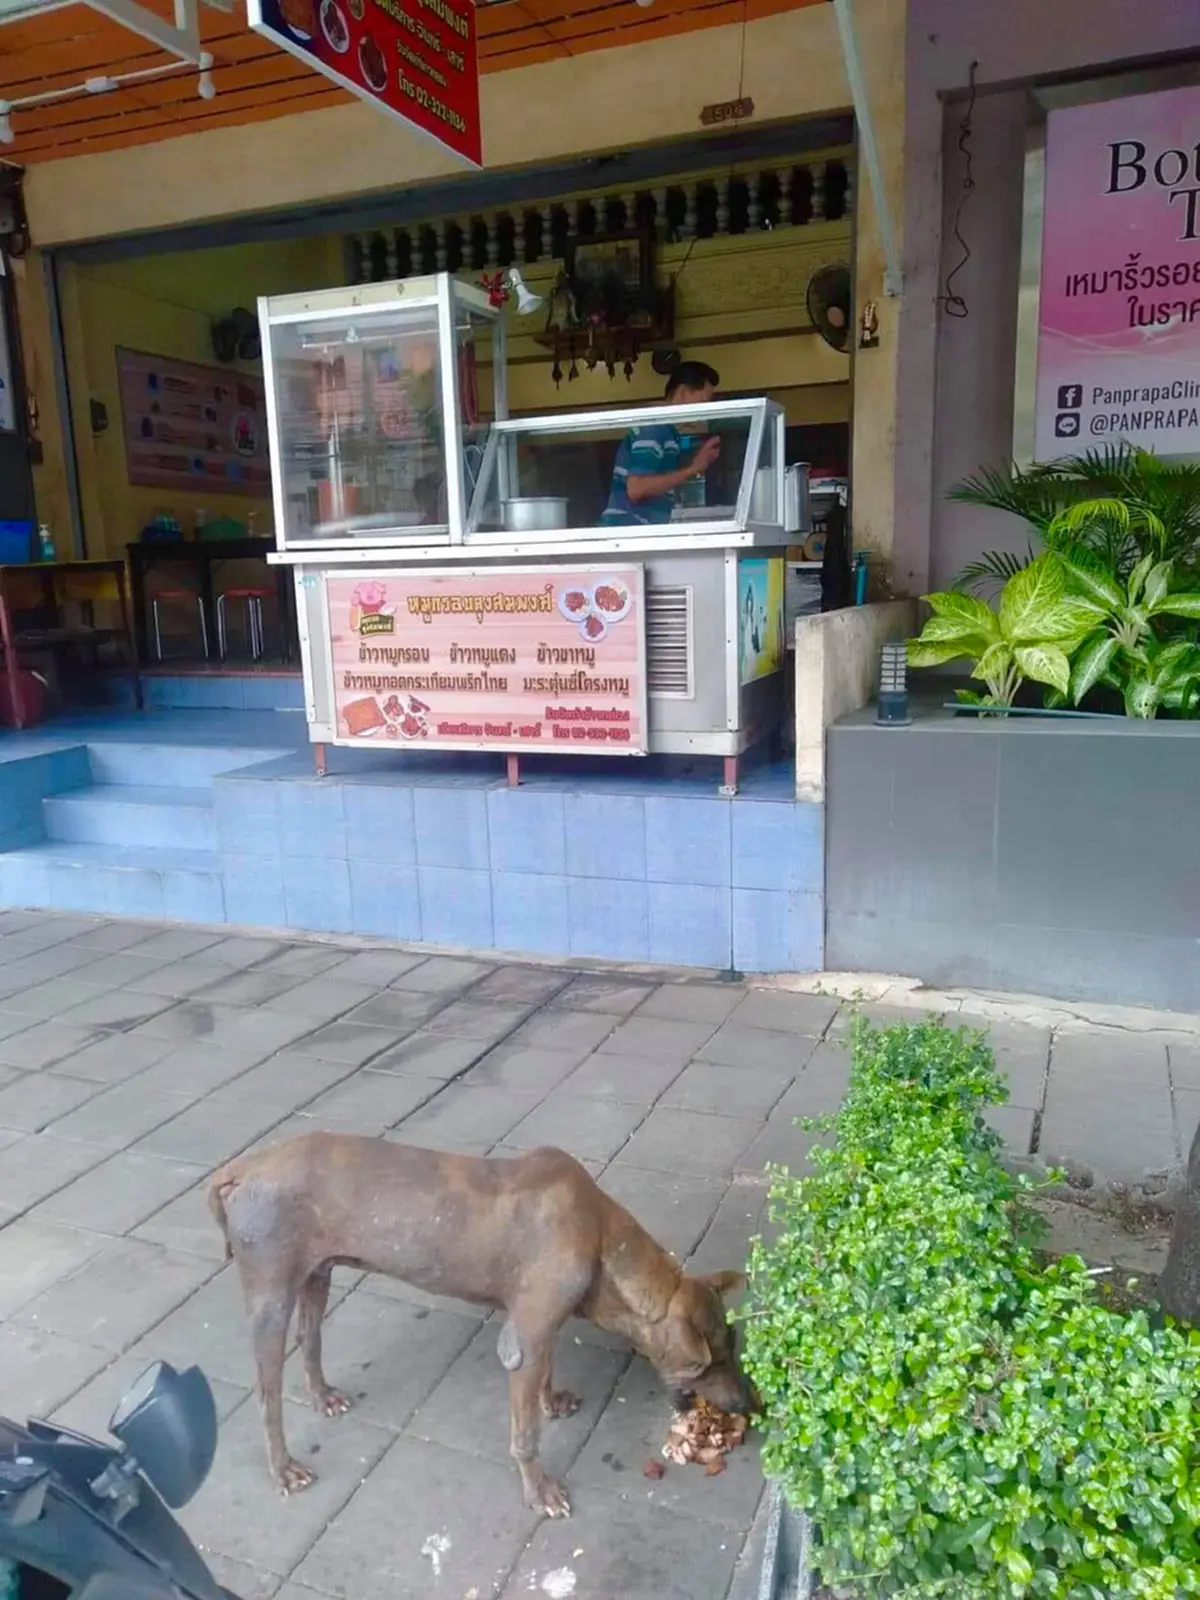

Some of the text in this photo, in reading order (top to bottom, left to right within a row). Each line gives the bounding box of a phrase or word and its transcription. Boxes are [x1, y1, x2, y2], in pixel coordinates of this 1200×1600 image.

[398, 67, 415, 98] โทร
[358, 641, 596, 669] ข้าวหมูกรอบ ข้าวหมูแดง ข้าวขาหมู
